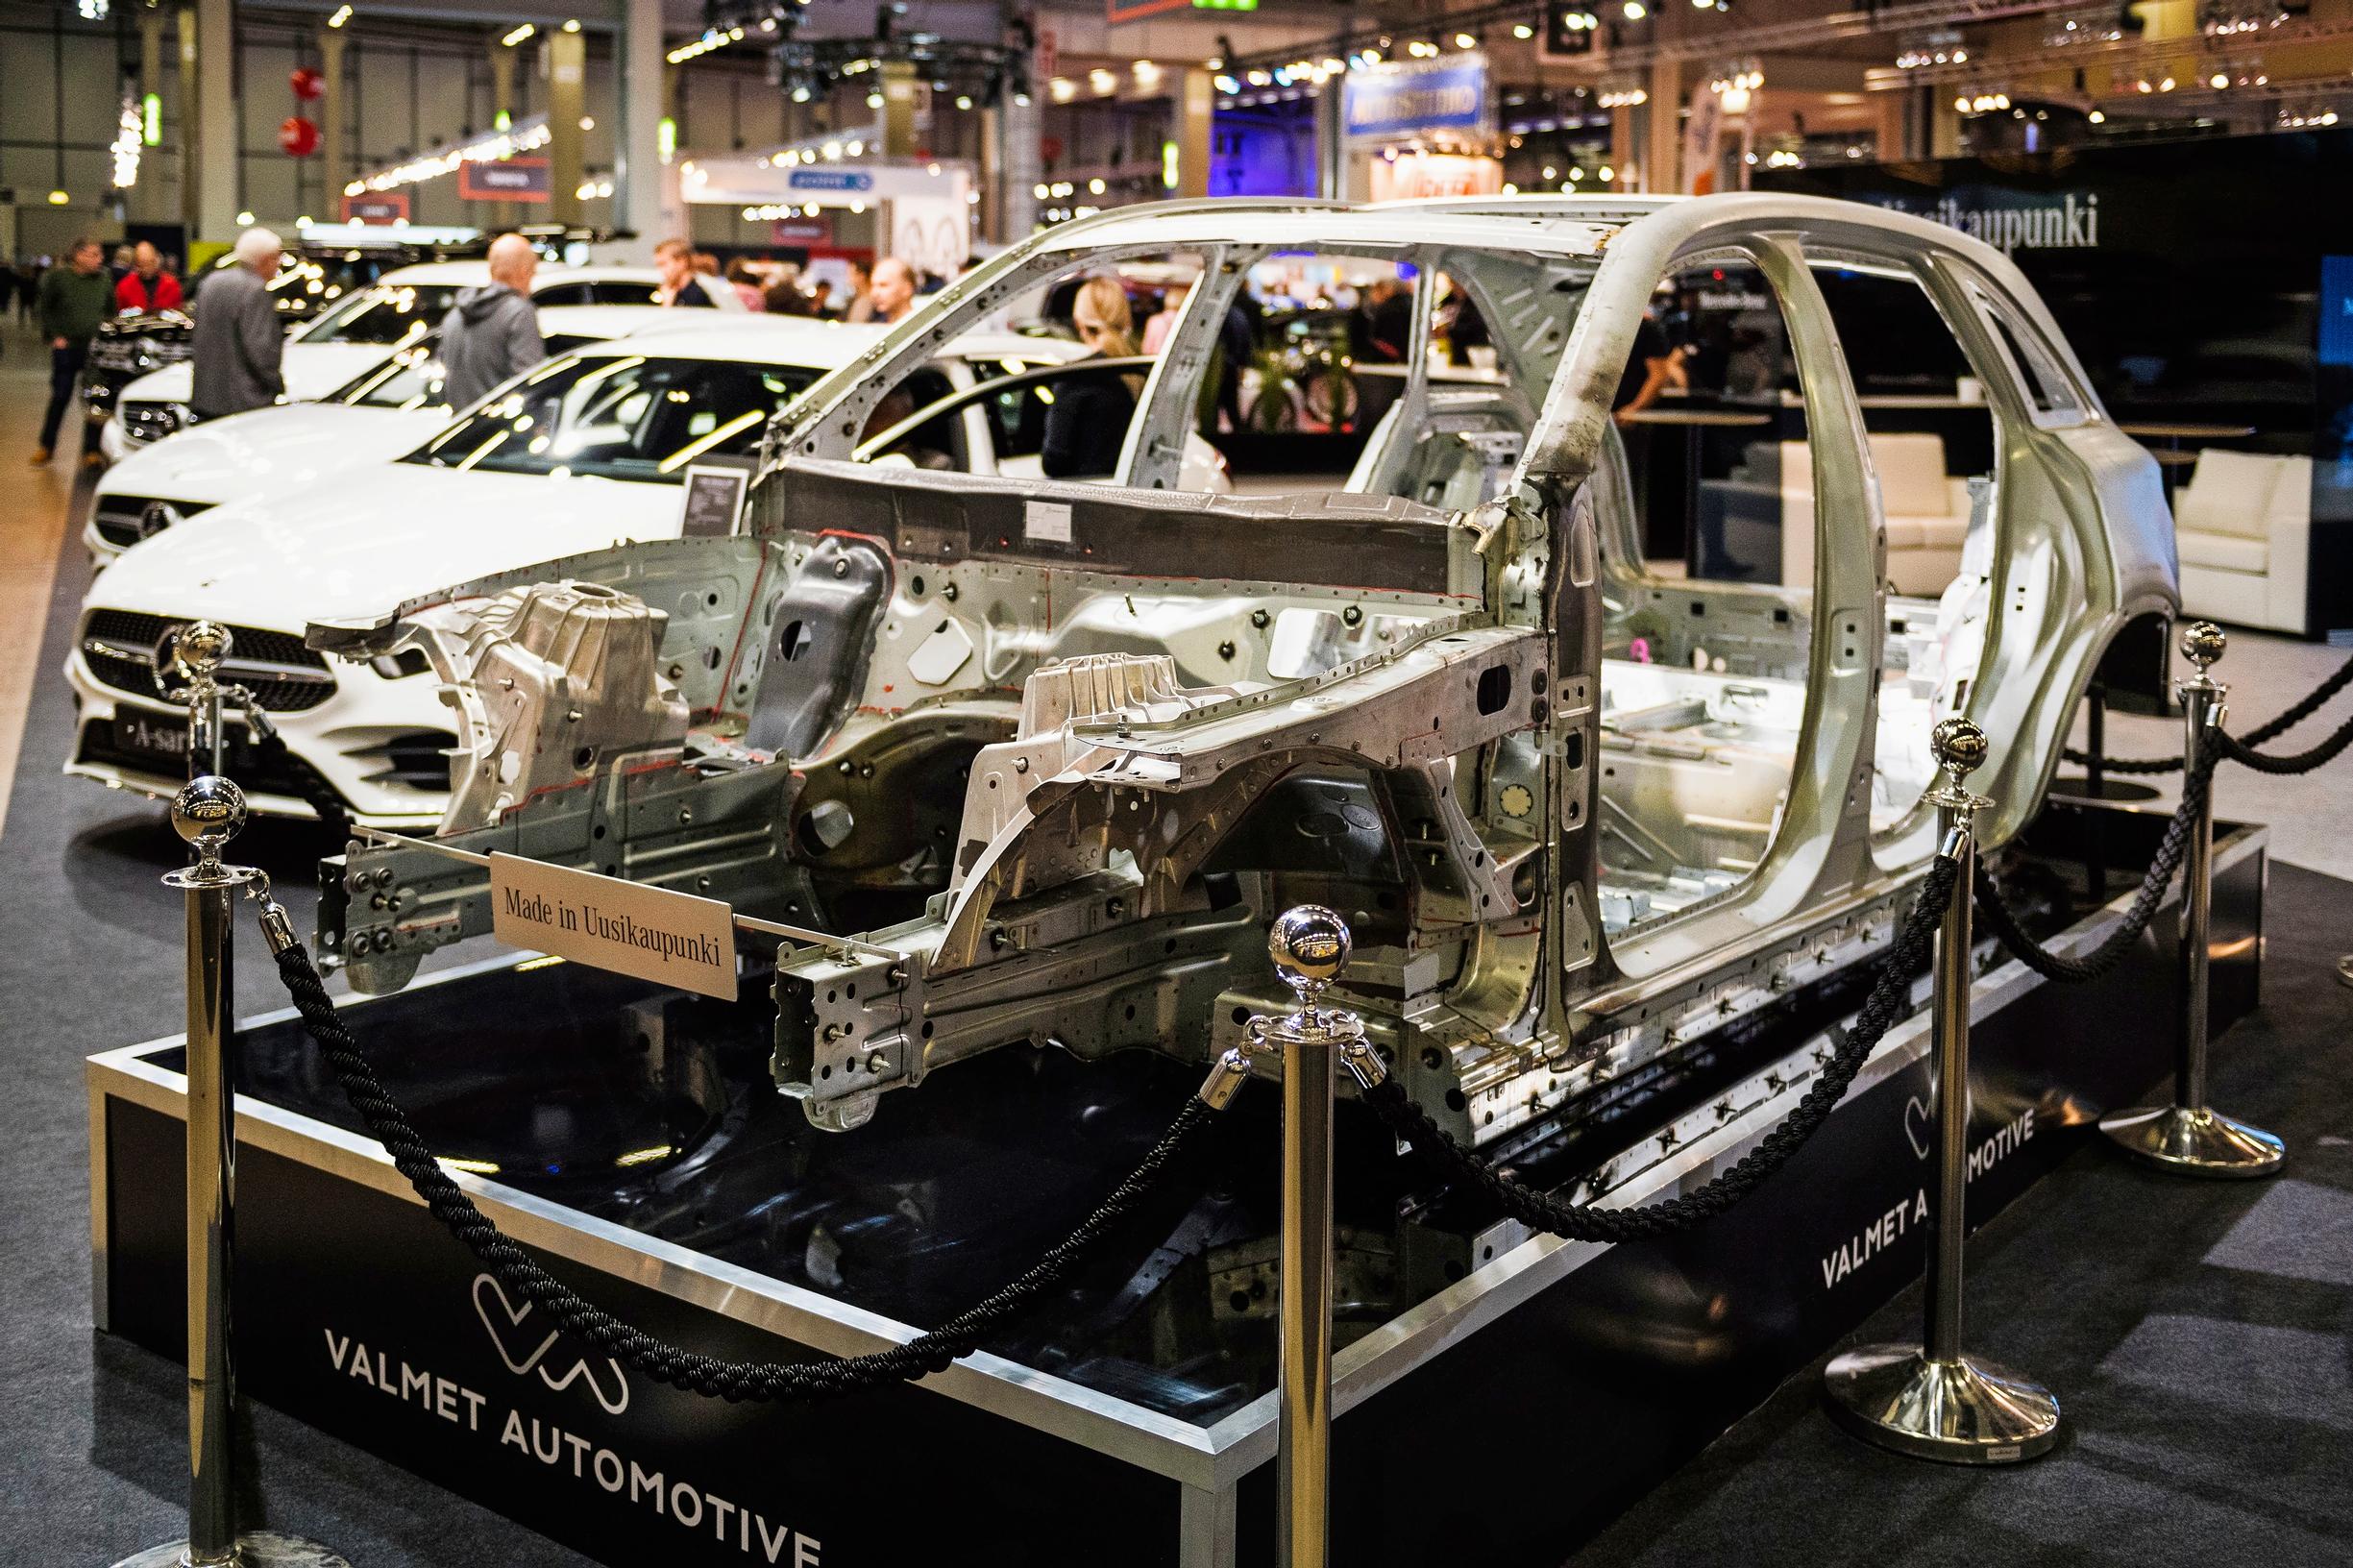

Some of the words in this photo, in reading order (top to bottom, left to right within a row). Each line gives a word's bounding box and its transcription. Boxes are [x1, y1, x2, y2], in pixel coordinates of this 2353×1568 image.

[1882, 193, 2098, 263] ikaupunki
[504, 887, 553, 925] Made
[558, 899, 577, 931] in
[583, 905, 721, 967] Uusikaupunki
[1822, 1199, 1909, 1289] VALMET
[324, 1328, 486, 1431] VALMET
